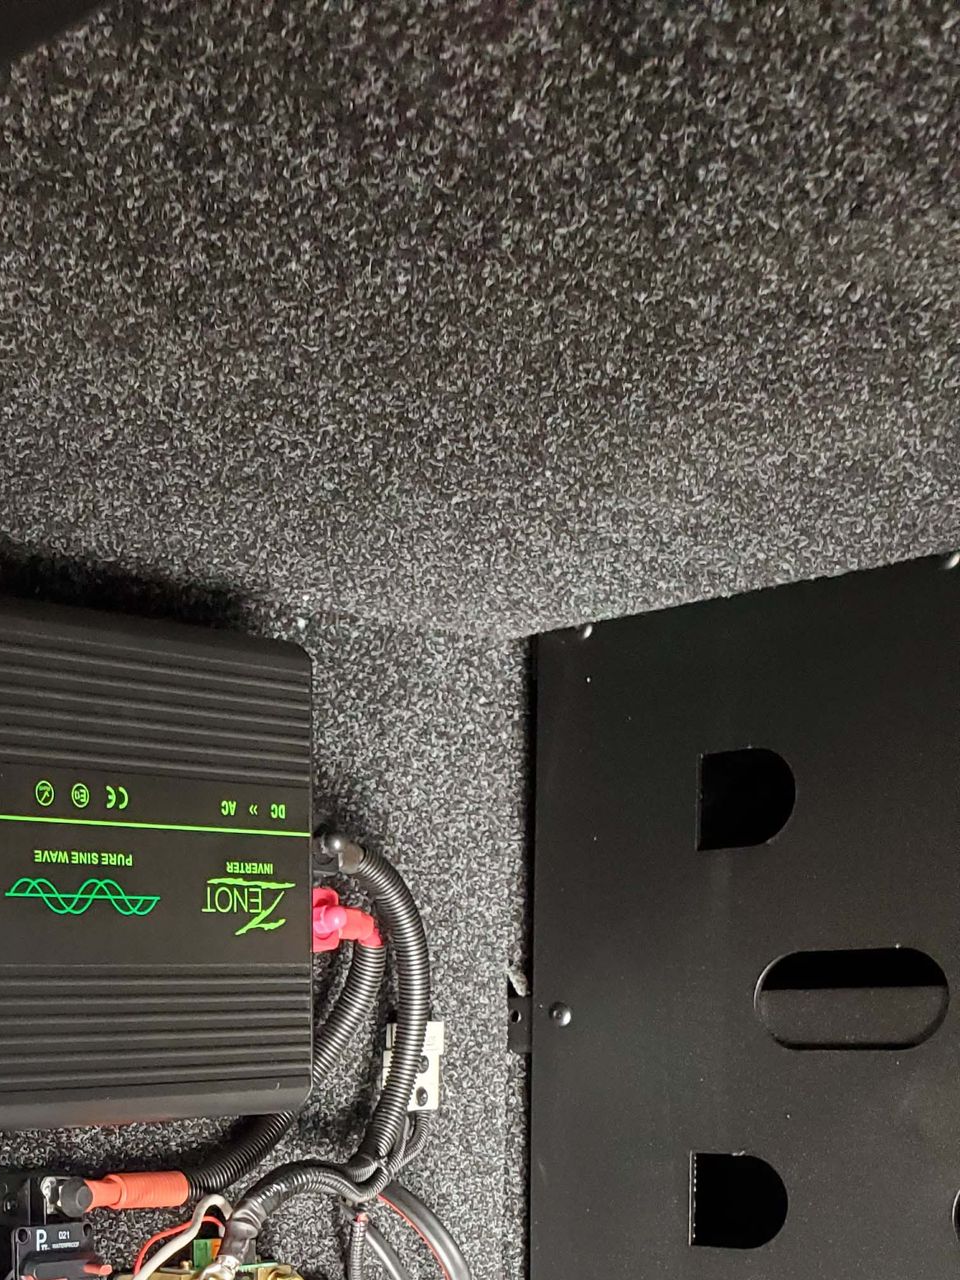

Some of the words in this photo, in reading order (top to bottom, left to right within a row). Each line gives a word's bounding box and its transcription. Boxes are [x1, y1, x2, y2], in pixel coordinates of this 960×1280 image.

[221, 800, 237, 816] AC
[270, 804, 286, 819] DC
[33, 849, 69, 864] WAVE
[71, 851, 99, 865] SINE
[100, 852, 133, 867] PURE
[225, 861, 274, 875] INVERTER
[201, 877, 296, 936] ZENOT
